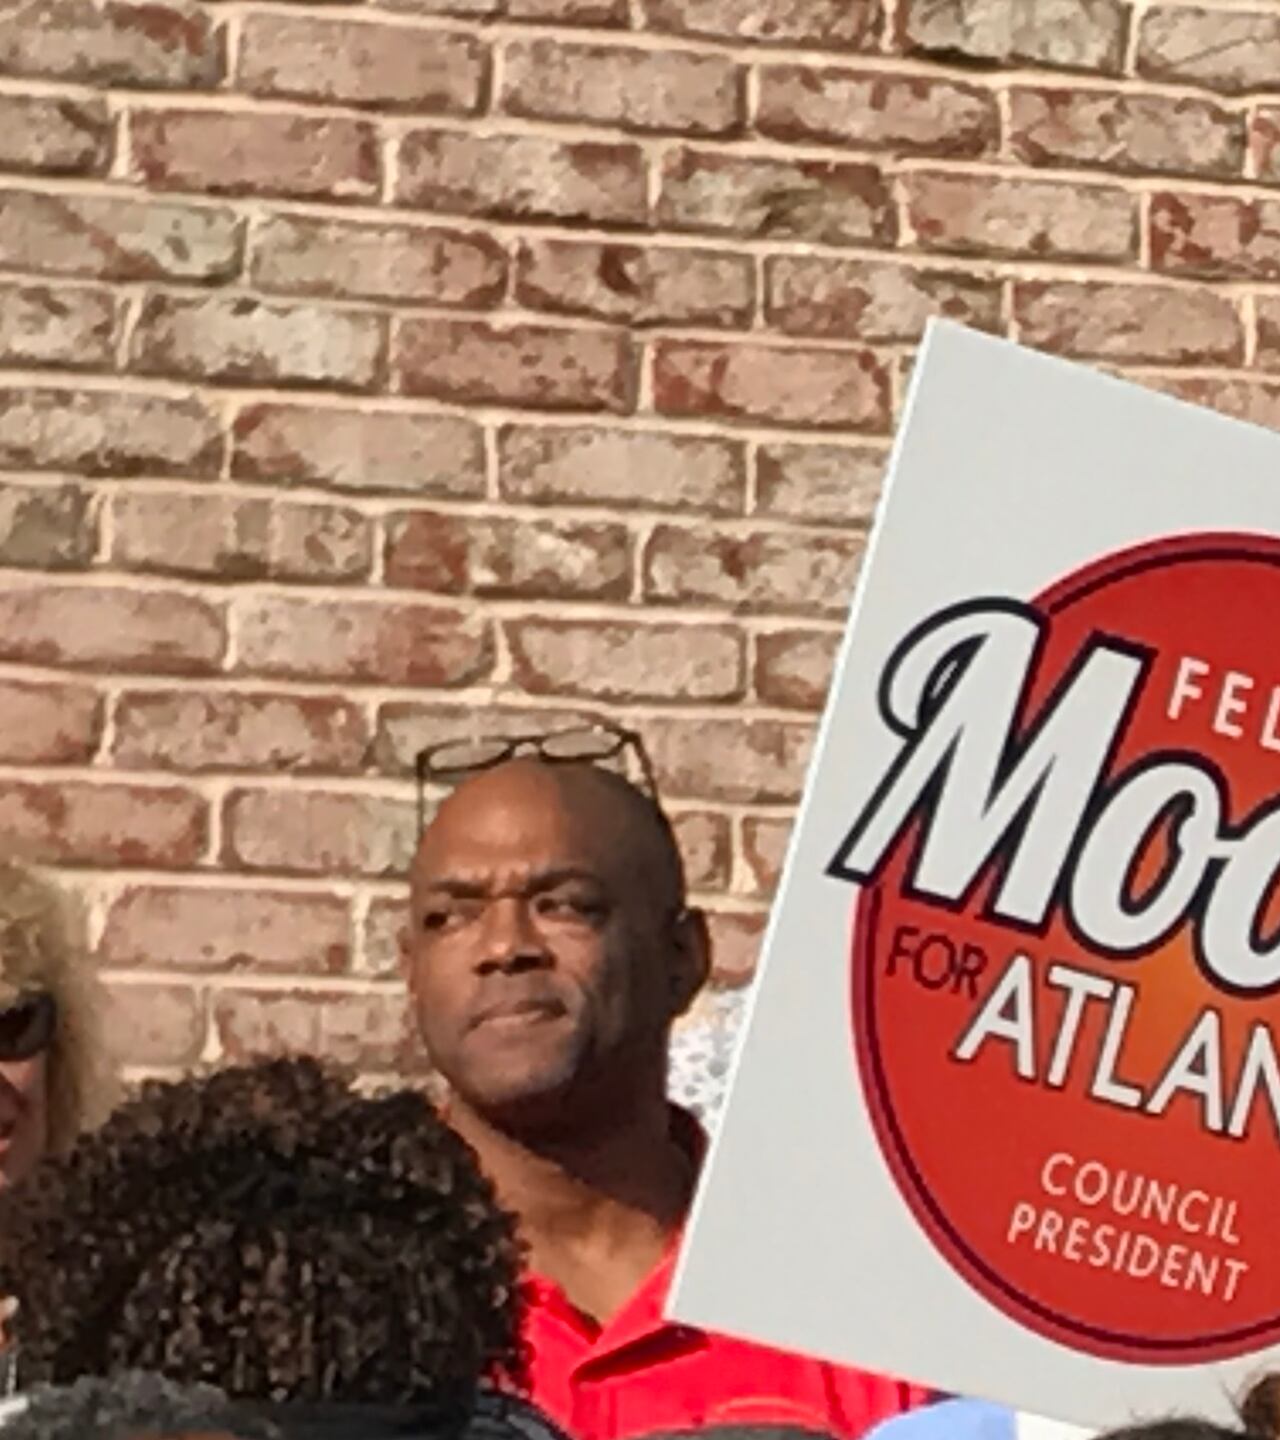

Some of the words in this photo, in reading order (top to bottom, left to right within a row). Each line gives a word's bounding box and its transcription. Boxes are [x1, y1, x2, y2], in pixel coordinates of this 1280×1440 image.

[885, 926, 985, 998] FOR
[1040, 1152, 1241, 1246] COUNCIL
[1007, 1203, 1248, 1303] PRESIDENT
